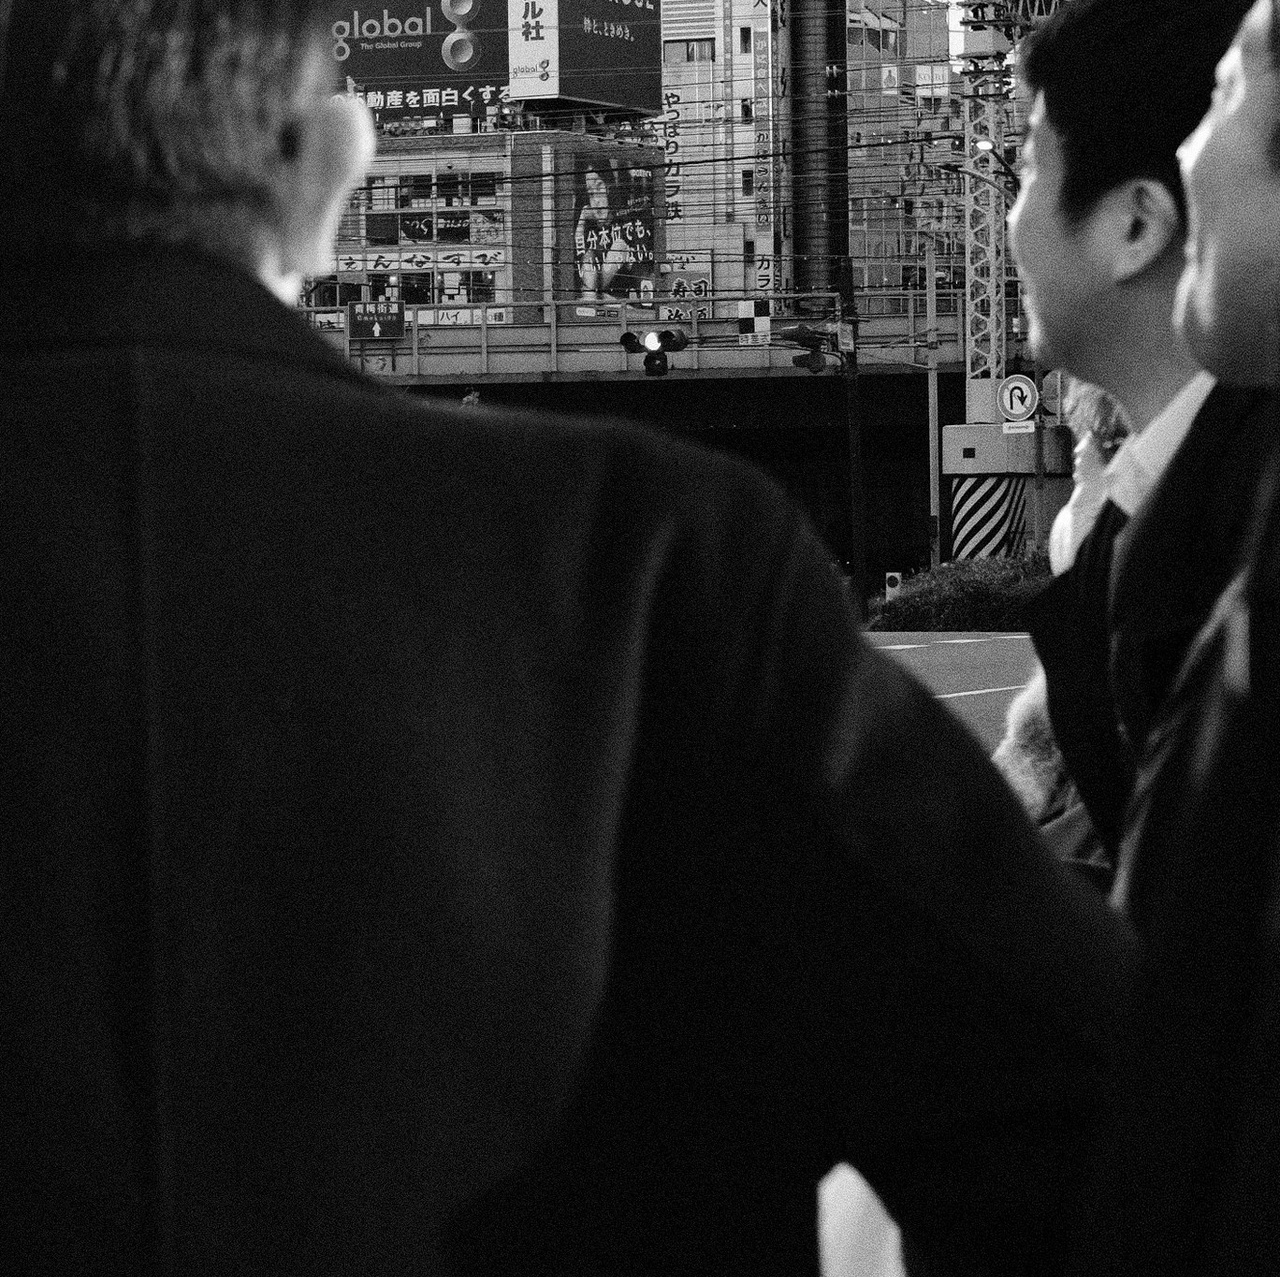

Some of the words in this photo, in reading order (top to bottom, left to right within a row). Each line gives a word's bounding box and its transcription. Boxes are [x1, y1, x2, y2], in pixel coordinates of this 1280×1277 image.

[331, 6, 432, 62] global
[360, 42, 374, 51] The
[375, 40, 399, 50] Global
[399, 40, 423, 50] Group
